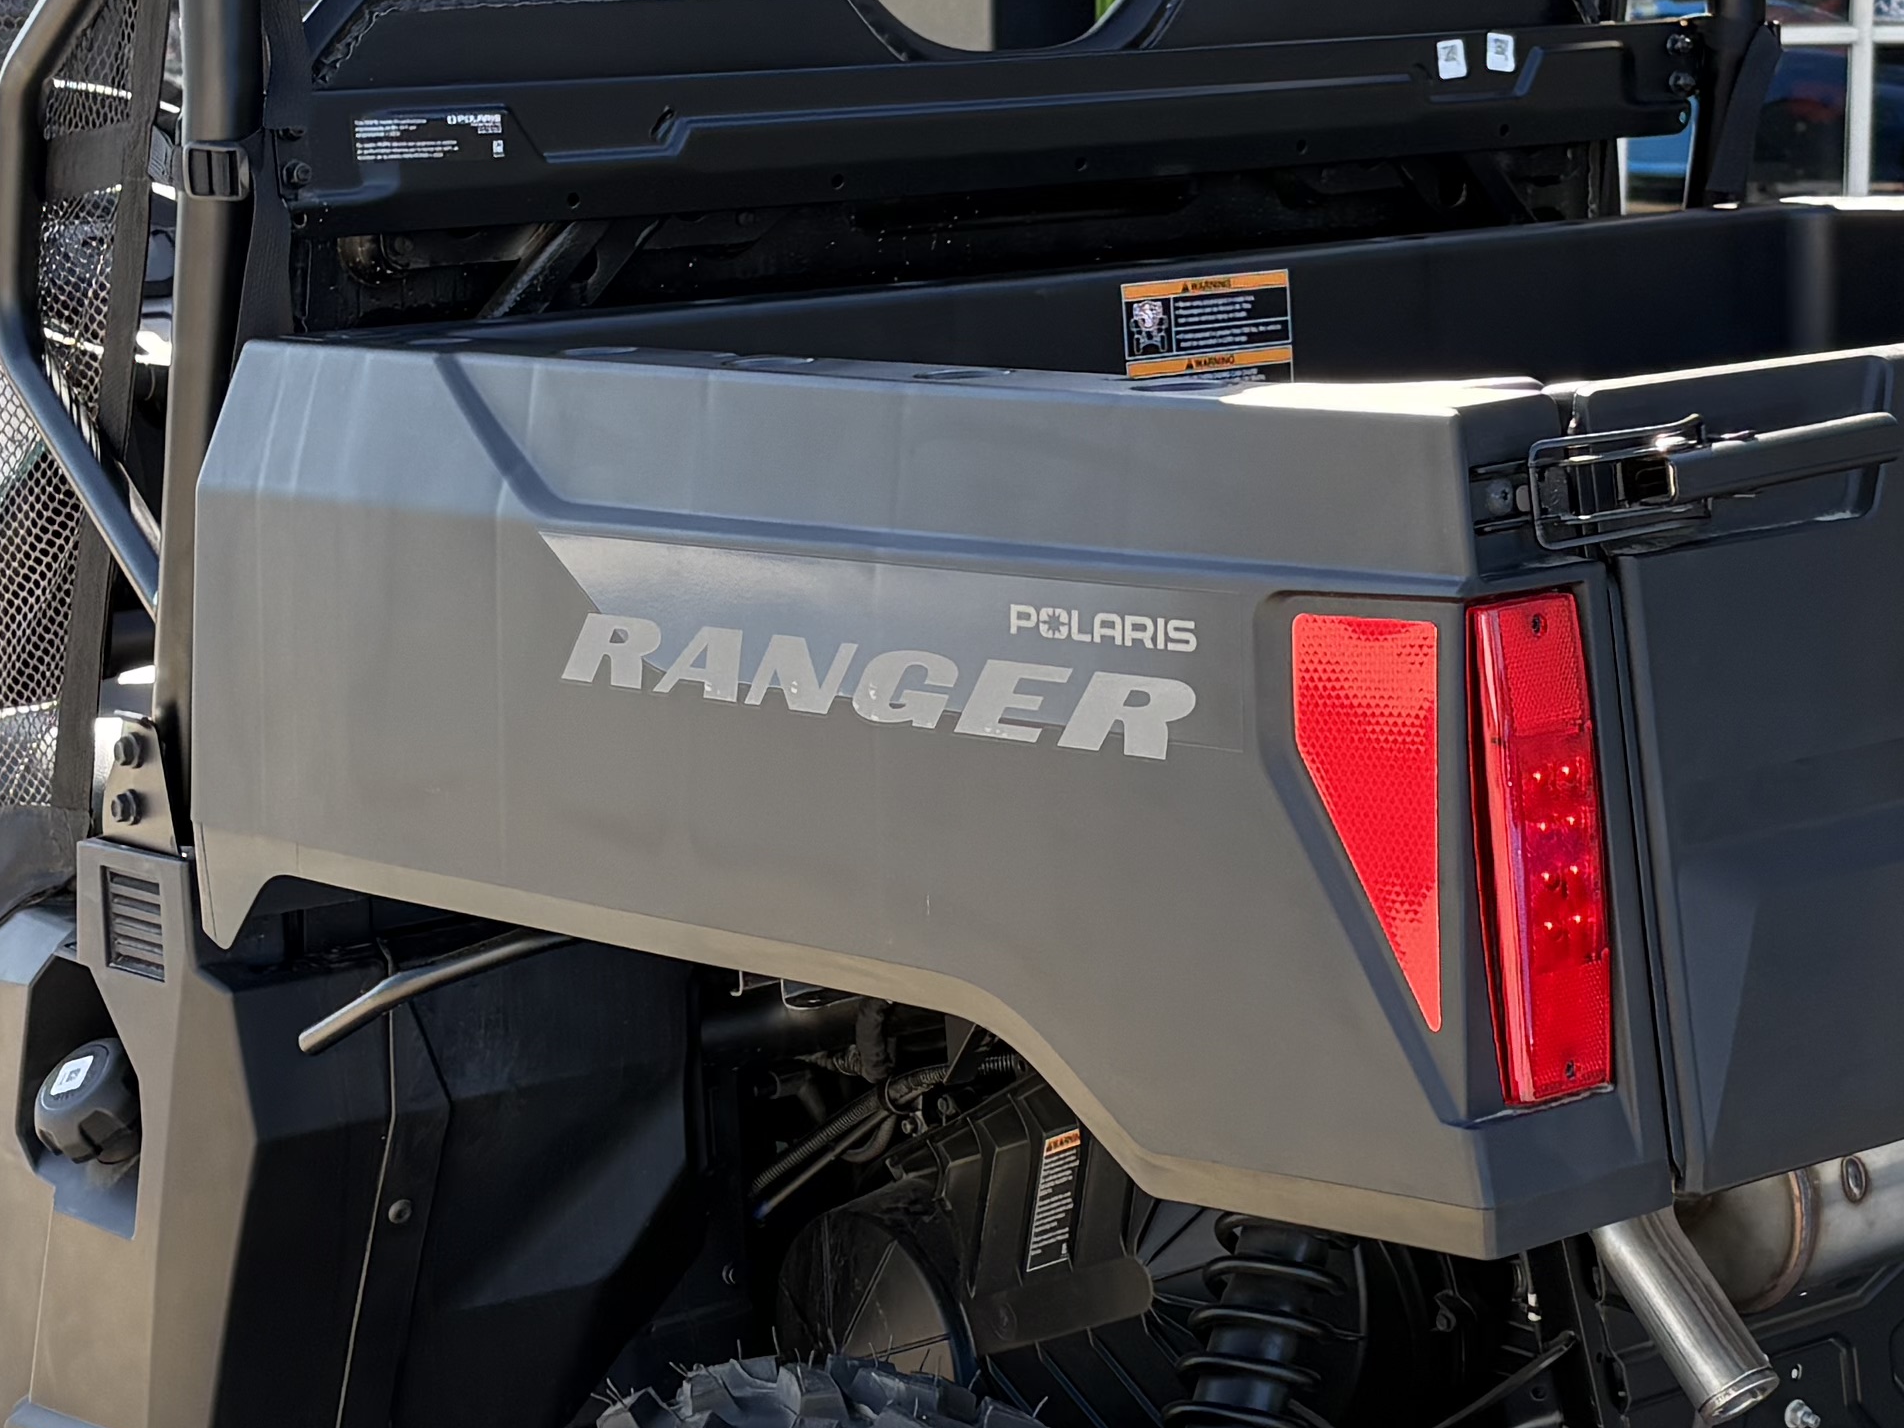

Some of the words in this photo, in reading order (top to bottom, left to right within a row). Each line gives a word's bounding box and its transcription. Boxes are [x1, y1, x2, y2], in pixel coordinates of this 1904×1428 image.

[1191, 278, 1232, 292] WARNING
[1194, 354, 1236, 368] WARNING
[1009, 603, 1197, 653] POLARIS
[561, 612, 1196, 761] RANGER
